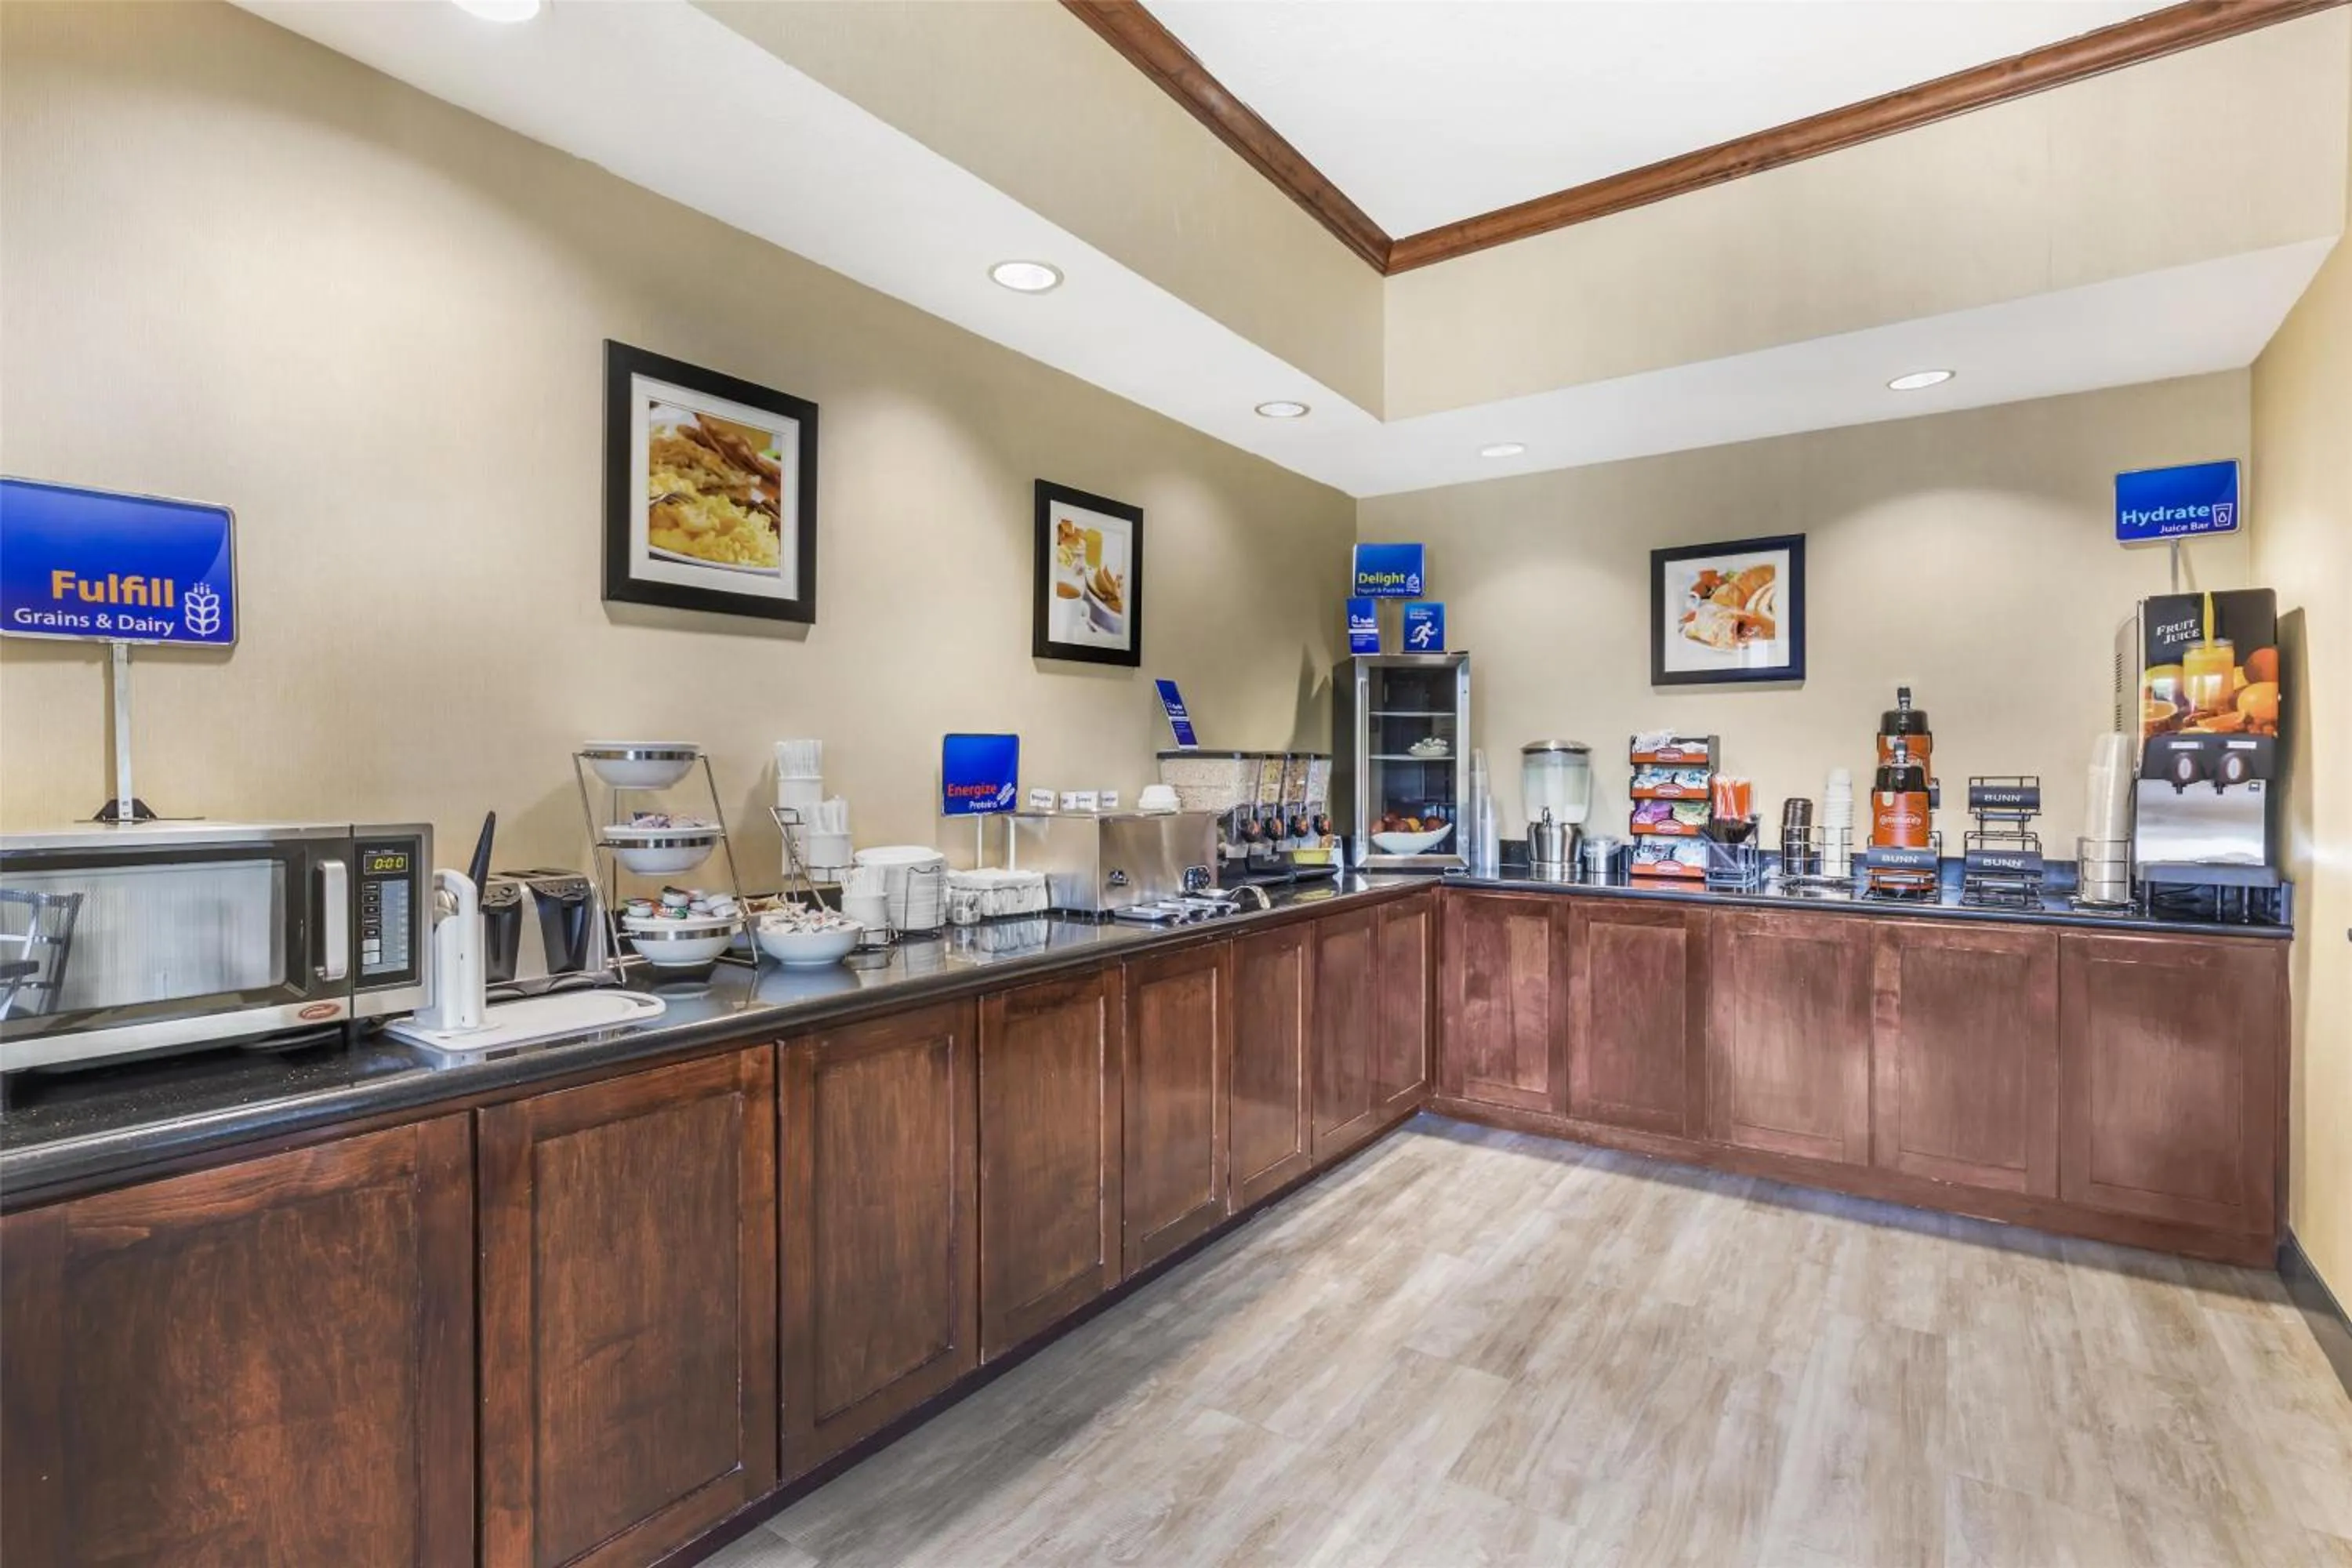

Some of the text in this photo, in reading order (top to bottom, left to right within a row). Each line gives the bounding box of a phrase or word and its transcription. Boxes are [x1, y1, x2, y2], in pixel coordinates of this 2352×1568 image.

[2121, 504, 2211, 528] Hydrate
[2158, 521, 2209, 534] Juice Bar
[1358, 571, 1406, 586] Delight
[51, 569, 175, 608] Fulfill
[13, 607, 175, 637] Grains & Dairy
[2157, 619, 2196, 636] FRUIT
[2164, 628, 2201, 644] JUICE
[947, 783, 997, 800] Energize
[1983, 793, 2021, 803] BUNN
[968, 800, 998, 811] Proteins
[1881, 854, 1920, 864] BUNN
[1982, 858, 2024, 869] BUNN
